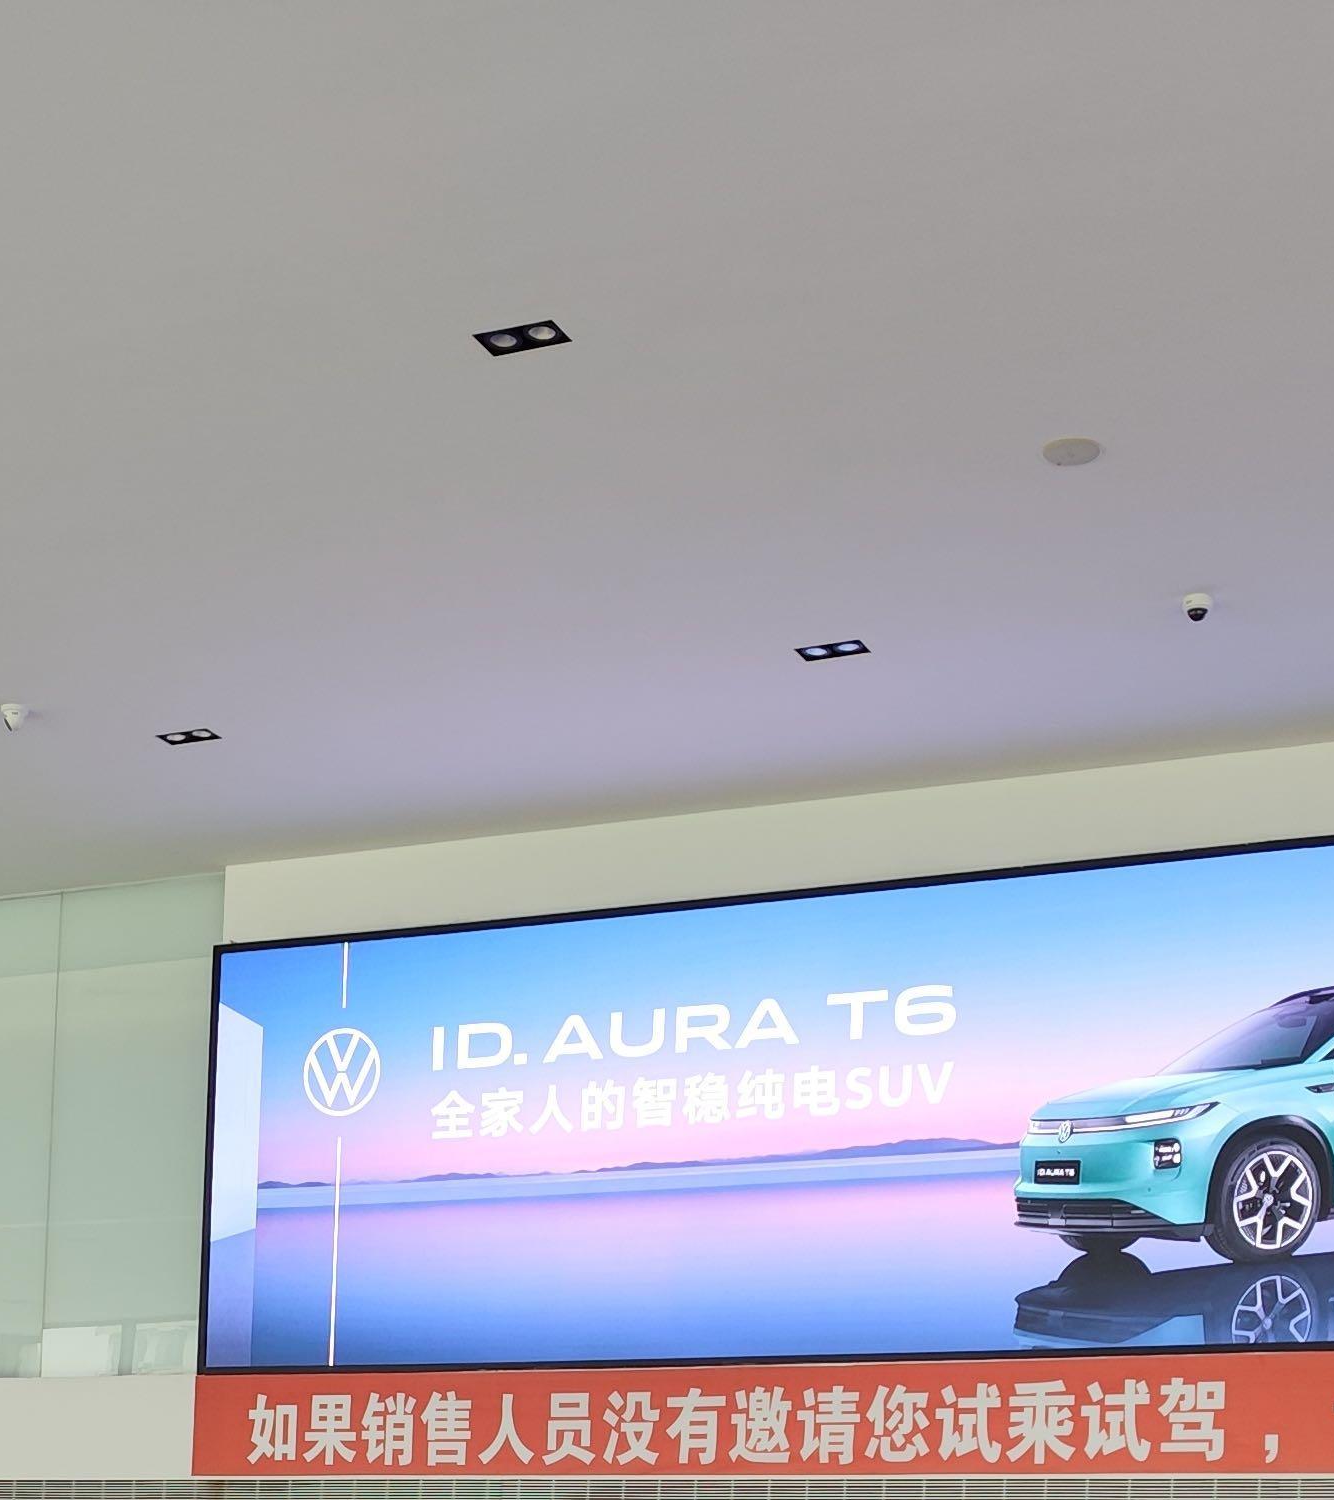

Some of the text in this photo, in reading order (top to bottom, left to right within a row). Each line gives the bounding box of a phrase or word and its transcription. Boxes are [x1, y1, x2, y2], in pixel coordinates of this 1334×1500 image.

[542, 997, 801, 1064] AURA
[826, 985, 960, 1042] T6
[431, 1061, 957, 1141] 全家人的智稳纯电SUV
